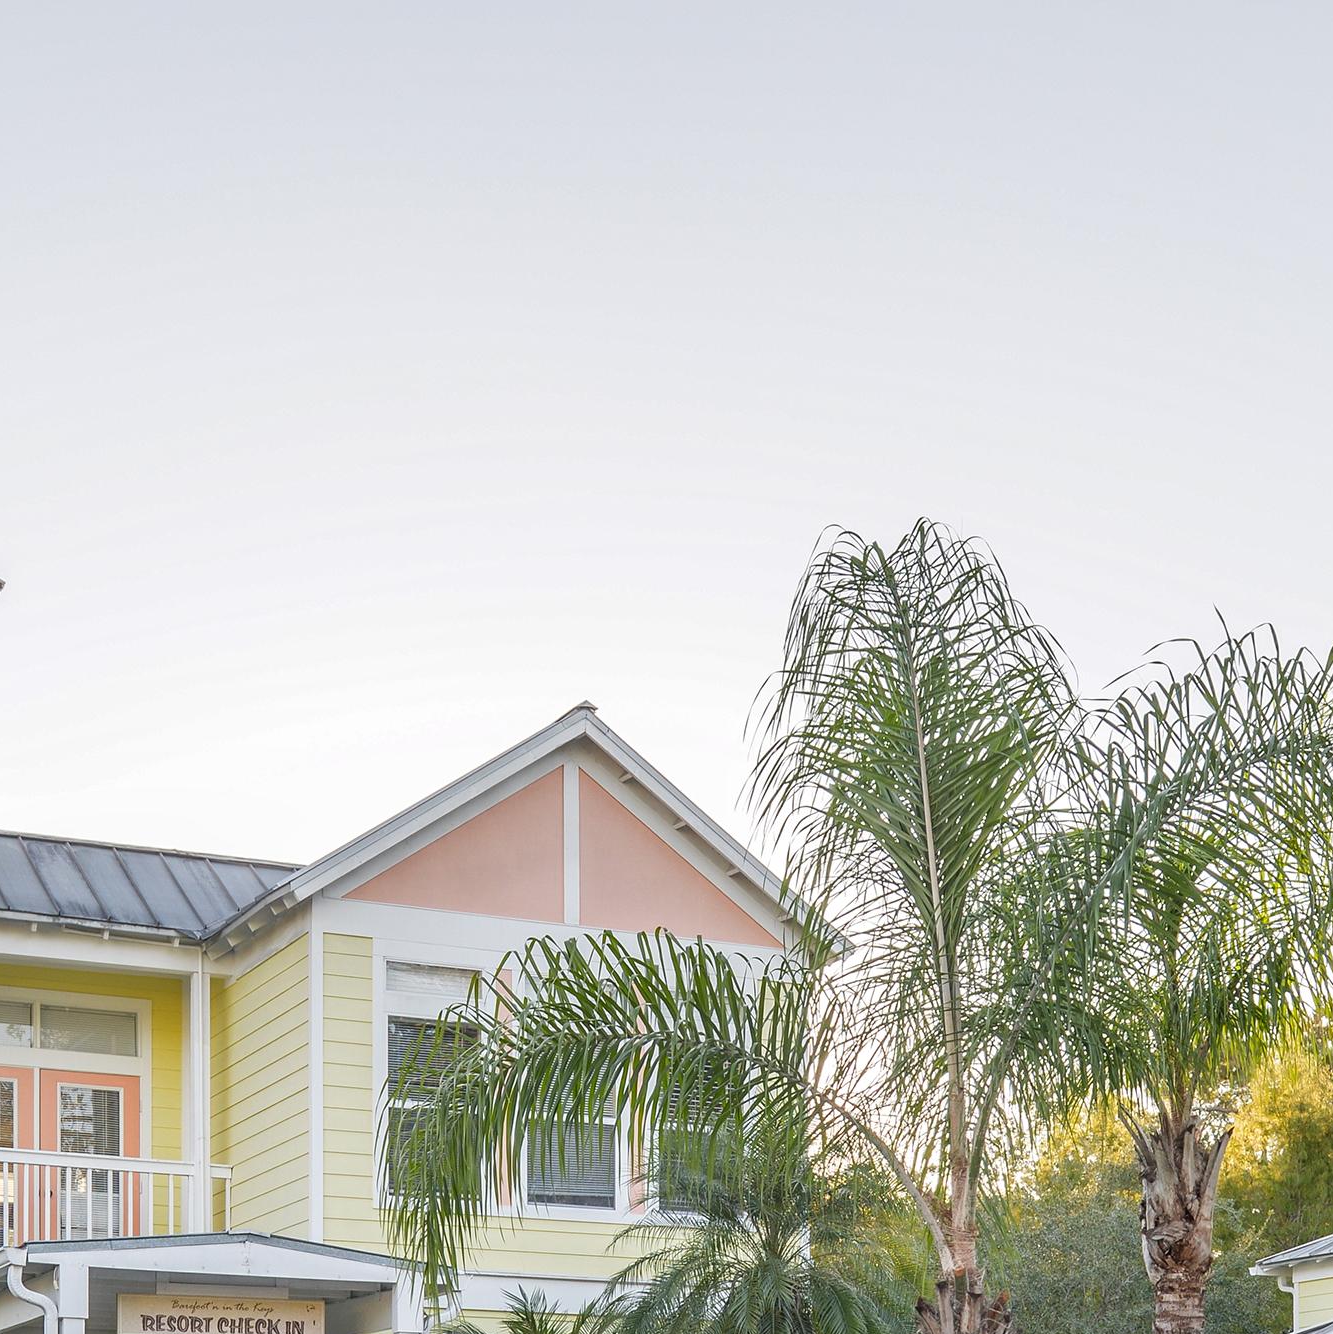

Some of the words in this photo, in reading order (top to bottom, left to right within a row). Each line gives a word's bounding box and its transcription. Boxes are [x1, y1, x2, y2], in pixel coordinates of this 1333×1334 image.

[171, 1299, 219, 1314] Barefoot'n
[222, 1303, 232, 1311] in
[233, 1302, 250, 1311] the
[252, 1302, 274, 1317] Keys
[140, 1314, 214, 1333] RESORT
